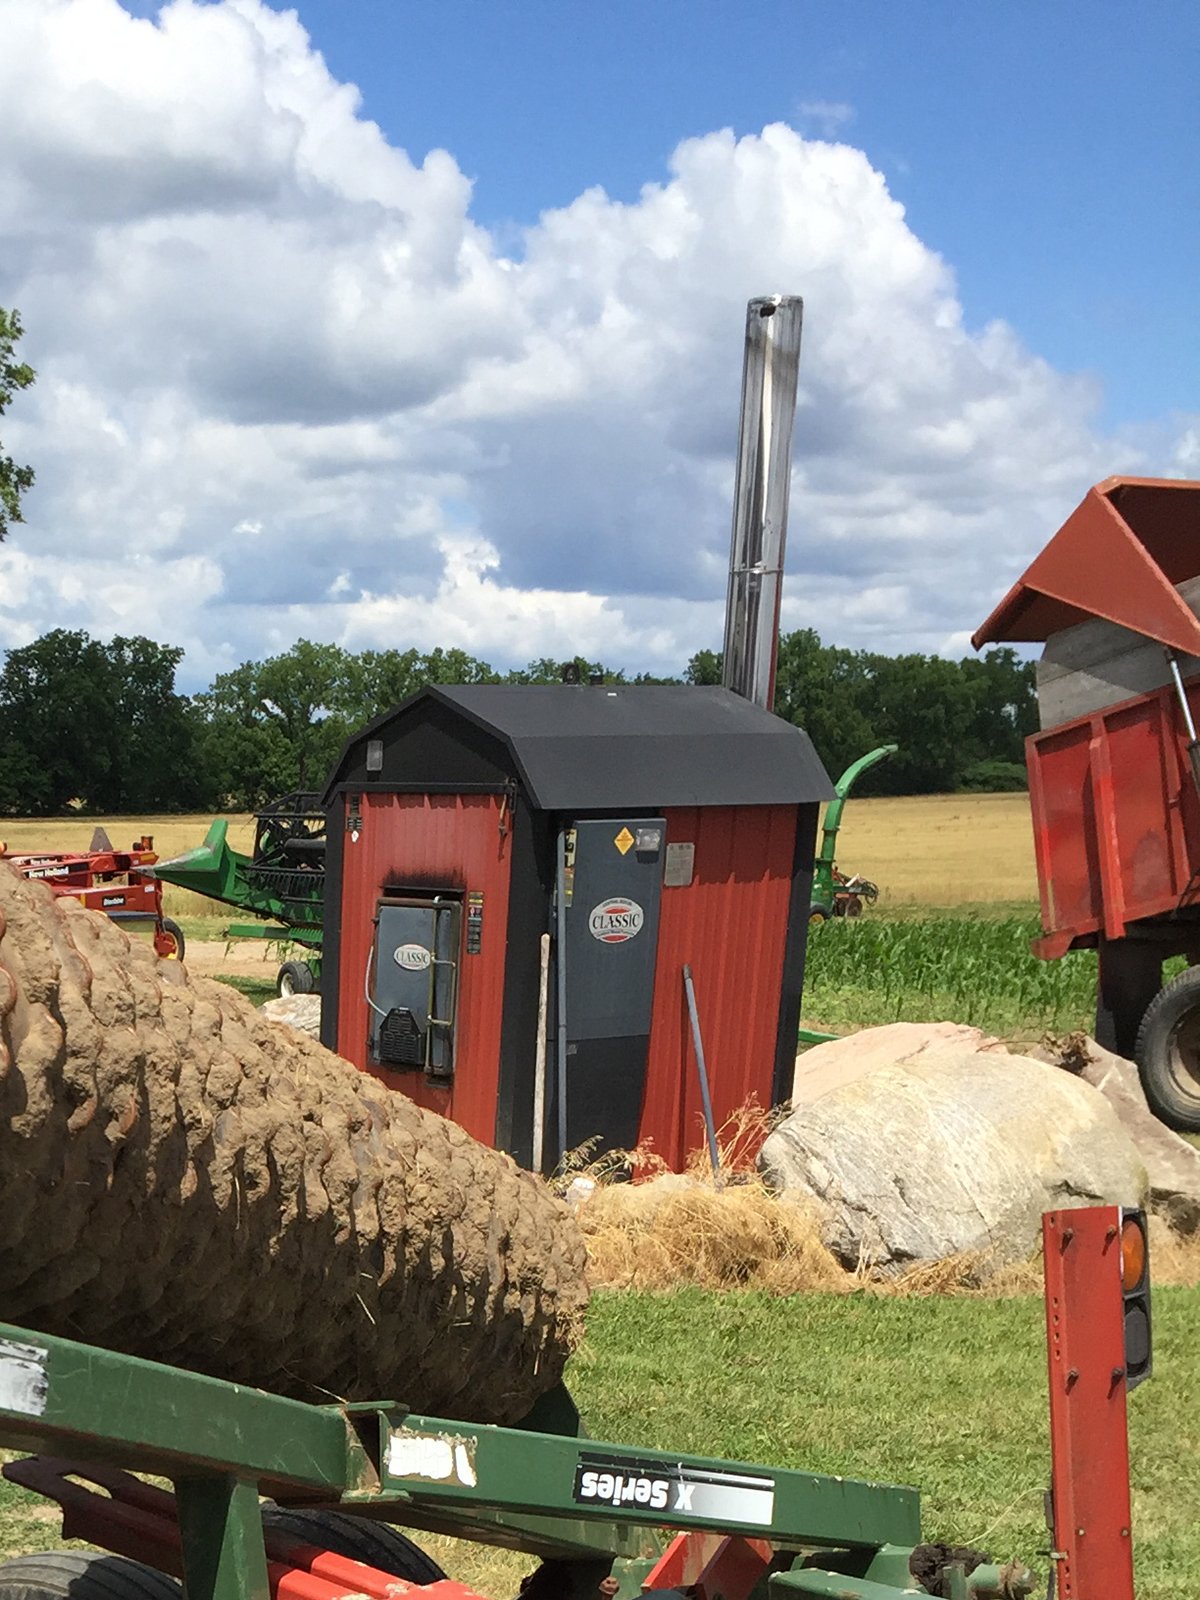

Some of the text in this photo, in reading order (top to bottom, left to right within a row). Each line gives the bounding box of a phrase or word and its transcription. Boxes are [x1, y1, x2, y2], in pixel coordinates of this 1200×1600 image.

[29, 866, 69, 879] New Holland
[592, 913, 640, 929] CLASSIC
[396, 950, 430, 966] CLASSIC
[580, 1470, 695, 1511] X Series
